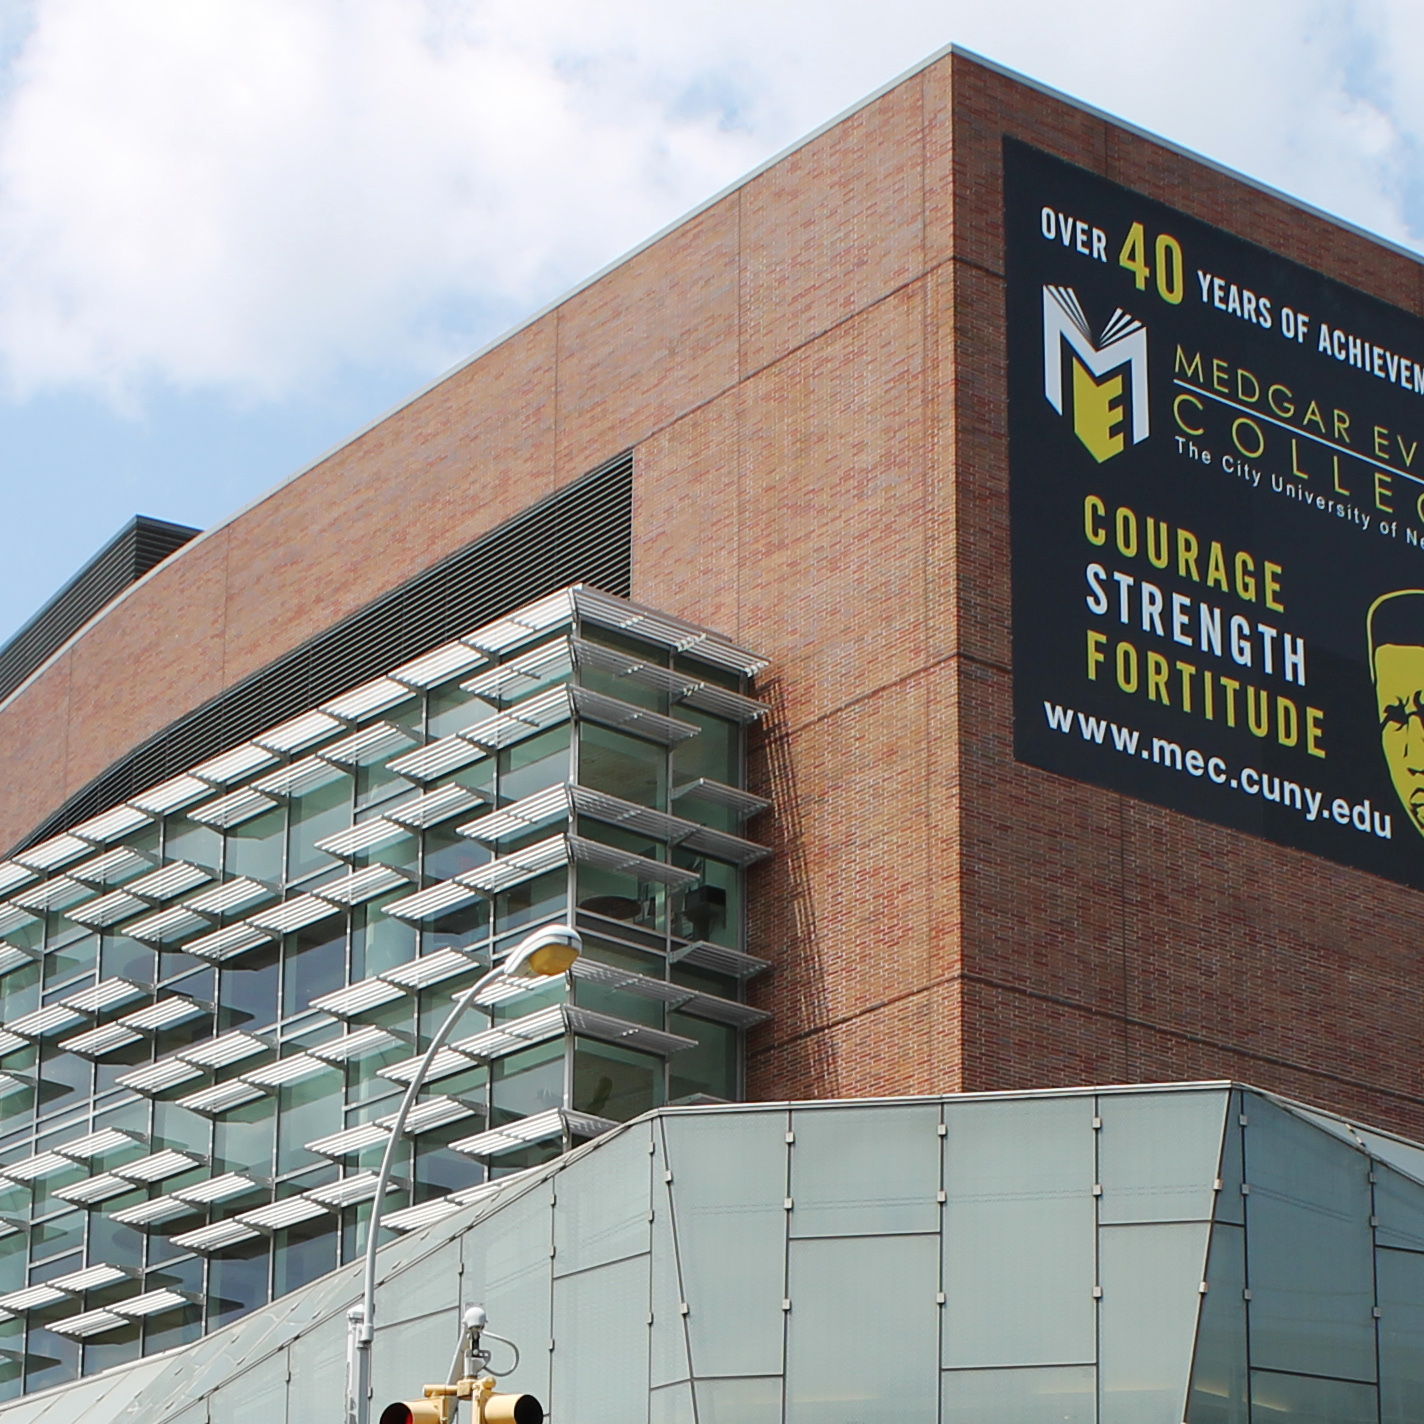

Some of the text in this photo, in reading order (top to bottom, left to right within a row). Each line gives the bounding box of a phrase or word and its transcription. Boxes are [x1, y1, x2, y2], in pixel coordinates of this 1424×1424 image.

[1041, 206, 1107, 263] OVER
[1119, 221, 1184, 304] 40
[1198, 270, 1272, 329] YEARS
[1281, 306, 1310, 343] OF
[1175, 345, 1350, 442] MEDGAR
[1175, 435, 1212, 464] The
[1223, 455, 1261, 487] City
[1272, 474, 1371, 530] University
[1380, 520, 1398, 538] of
[1084, 495, 1284, 613] COURAGE
[1086, 563, 1305, 686] STRENGTH
[1087, 629, 1325, 758] FORTITUDE
[1044, 701, 1392, 839] www.mec.cuny.edu
